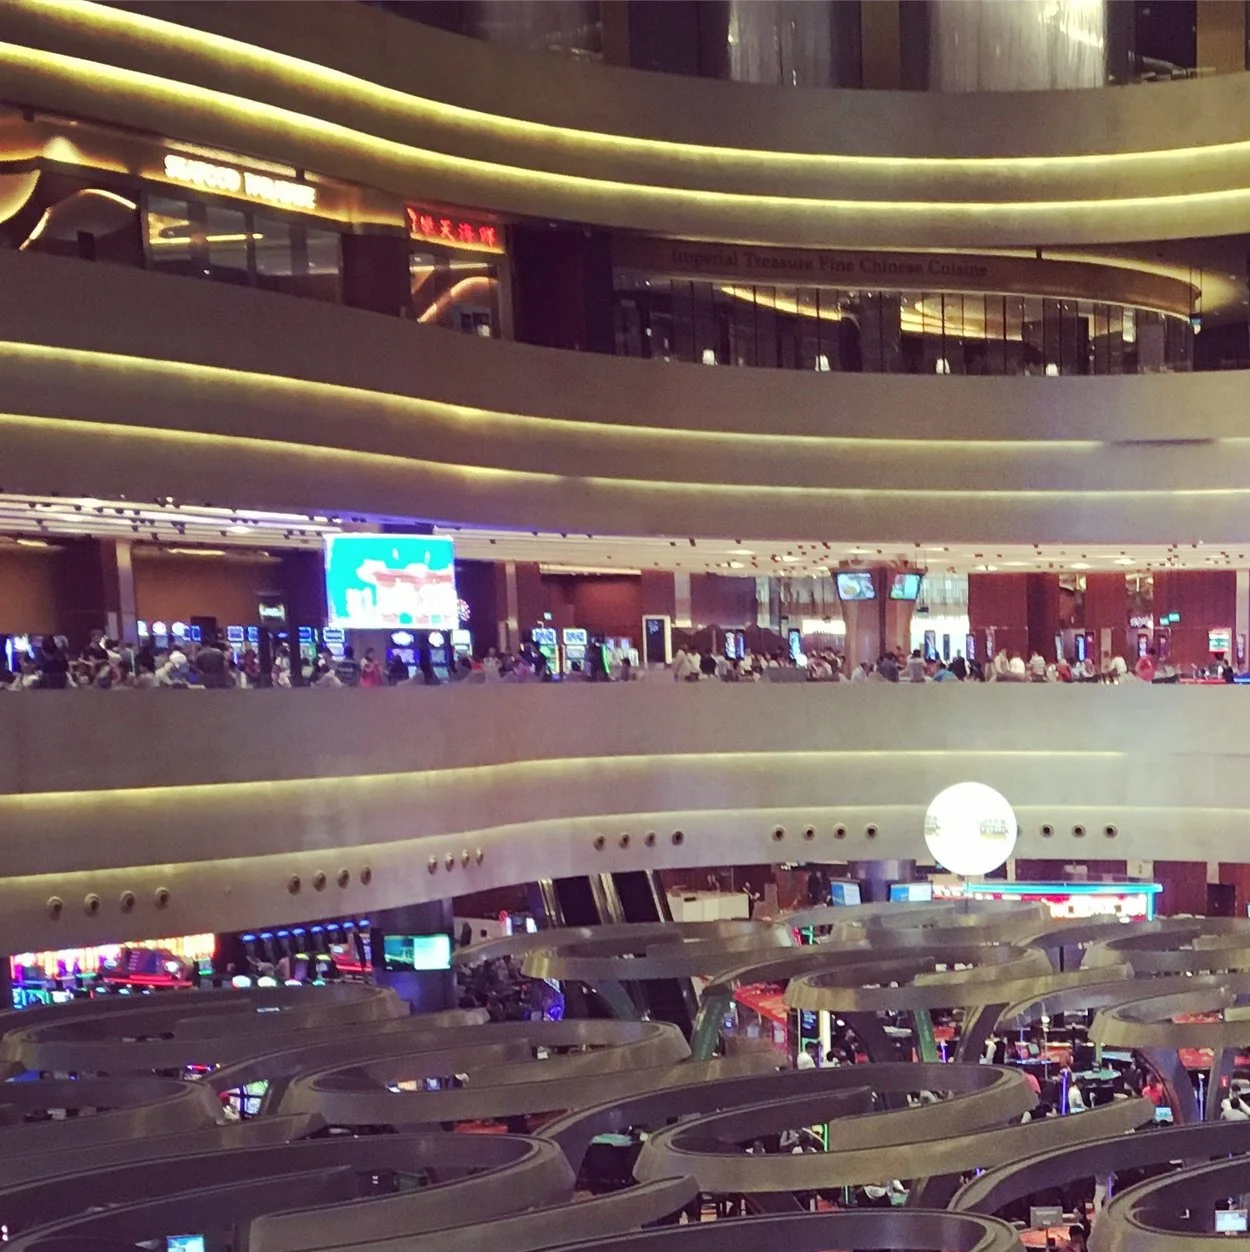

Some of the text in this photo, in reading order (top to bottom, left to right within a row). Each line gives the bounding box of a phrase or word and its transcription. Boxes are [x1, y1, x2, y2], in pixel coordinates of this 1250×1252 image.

[743, 251, 814, 270] Treasure
[818, 255, 854, 272] Fine
[859, 257, 924, 274] Chinese
[928, 260, 988, 276] Cuisine
